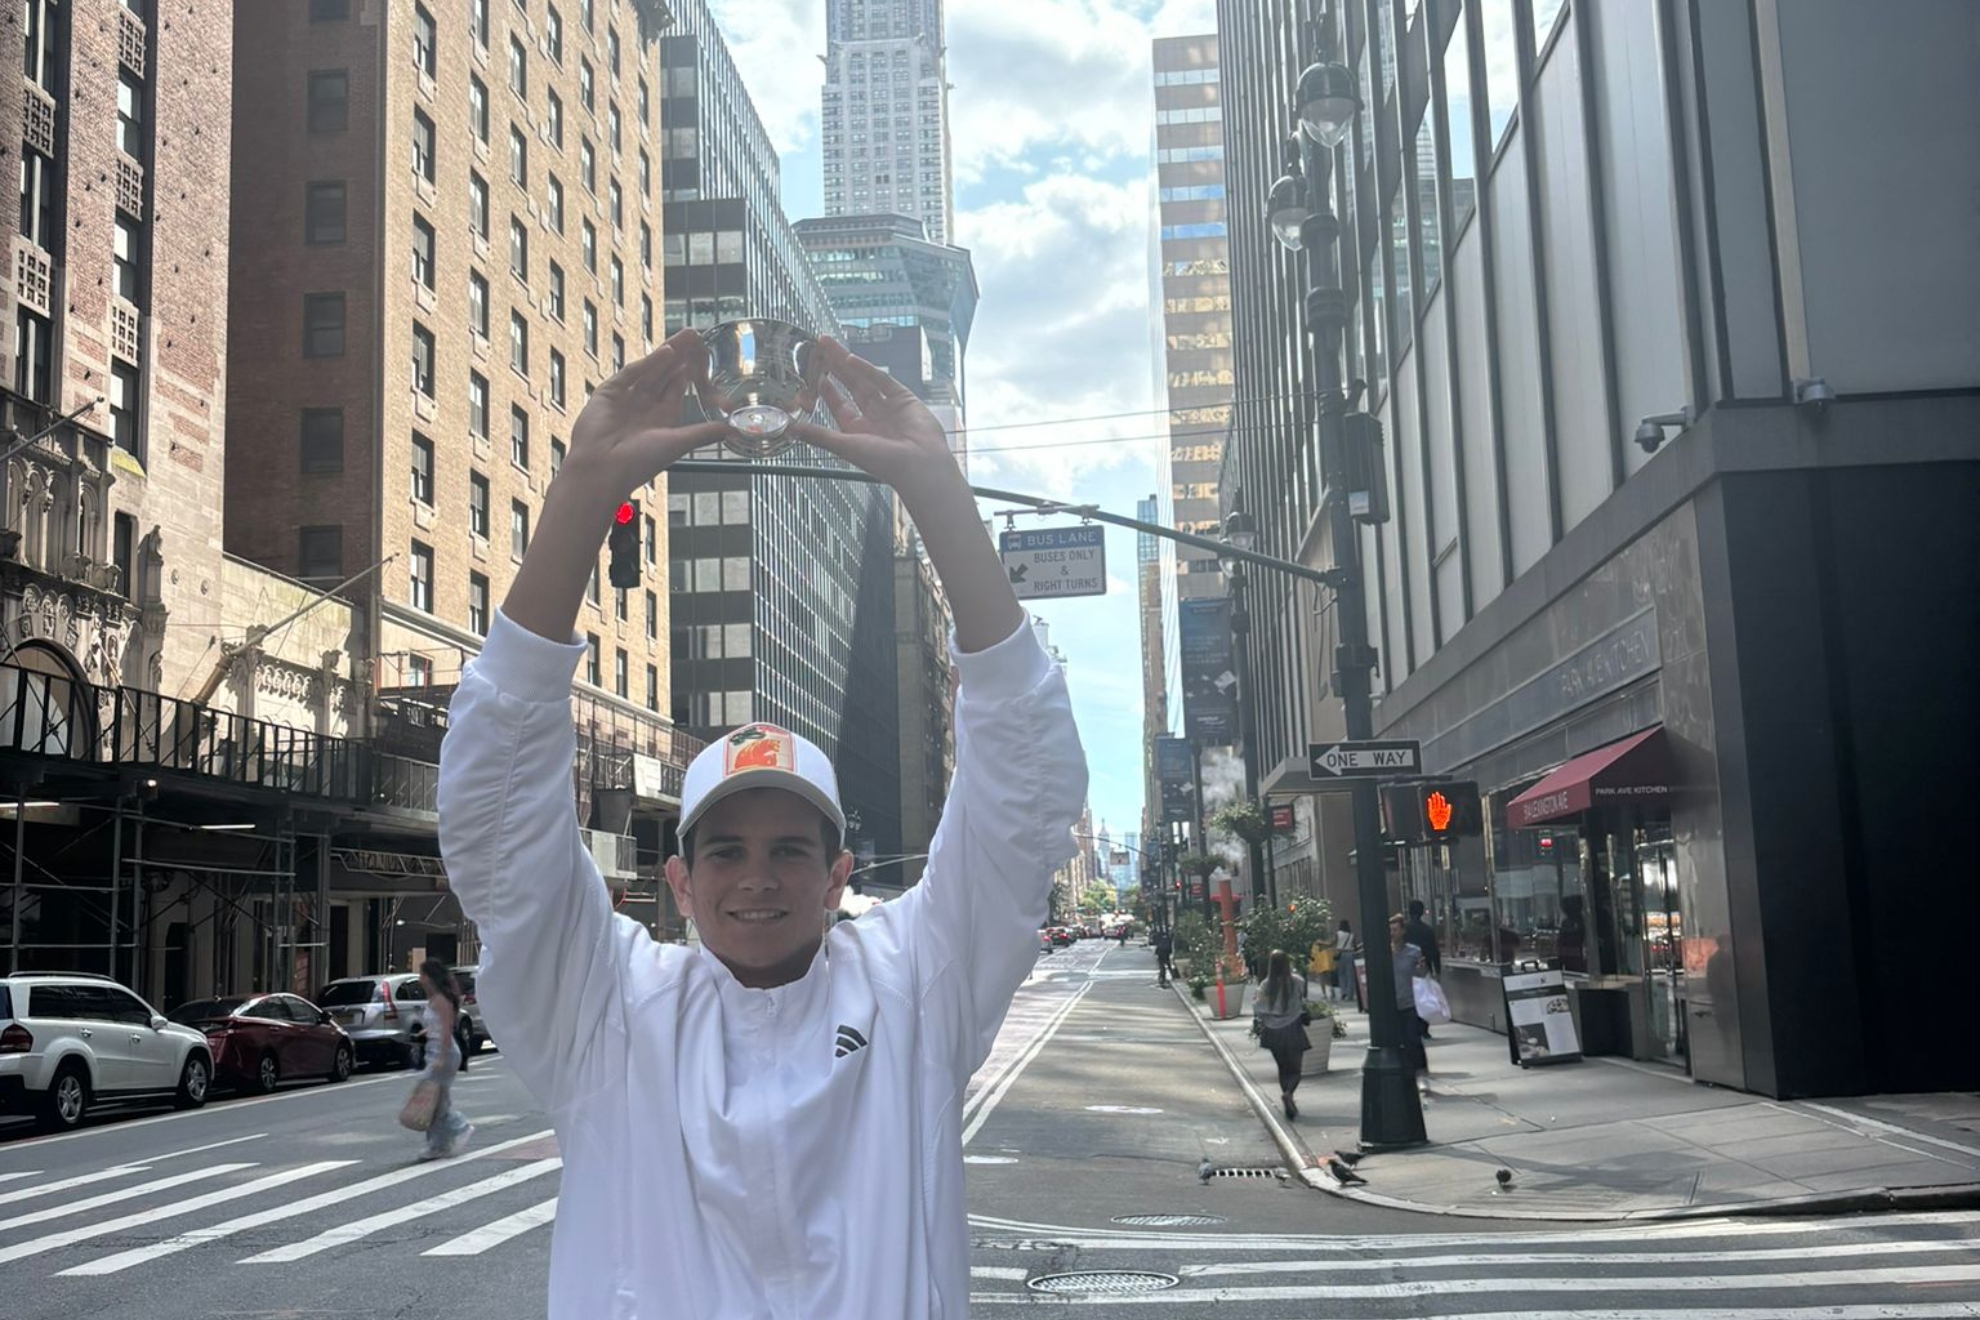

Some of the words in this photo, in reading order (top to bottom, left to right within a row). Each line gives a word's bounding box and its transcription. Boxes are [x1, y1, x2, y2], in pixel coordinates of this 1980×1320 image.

[1027, 534, 1054, 546] BUS
[1059, 531, 1096, 544] LANE
[1034, 551, 1066, 563] BUSES
[1069, 550, 1094, 561] ONLY
[1060, 565, 1070, 576] &
[1034, 580, 1062, 592] RIGHT
[1066, 578, 1097, 589] TURNS
[1327, 753, 1359, 768] ONE
[1373, 751, 1406, 766] WAY
[1595, 787, 1615, 795] PARK
[1617, 787, 1632, 795] AVE
[1633, 786, 1668, 794] KITCHEN
